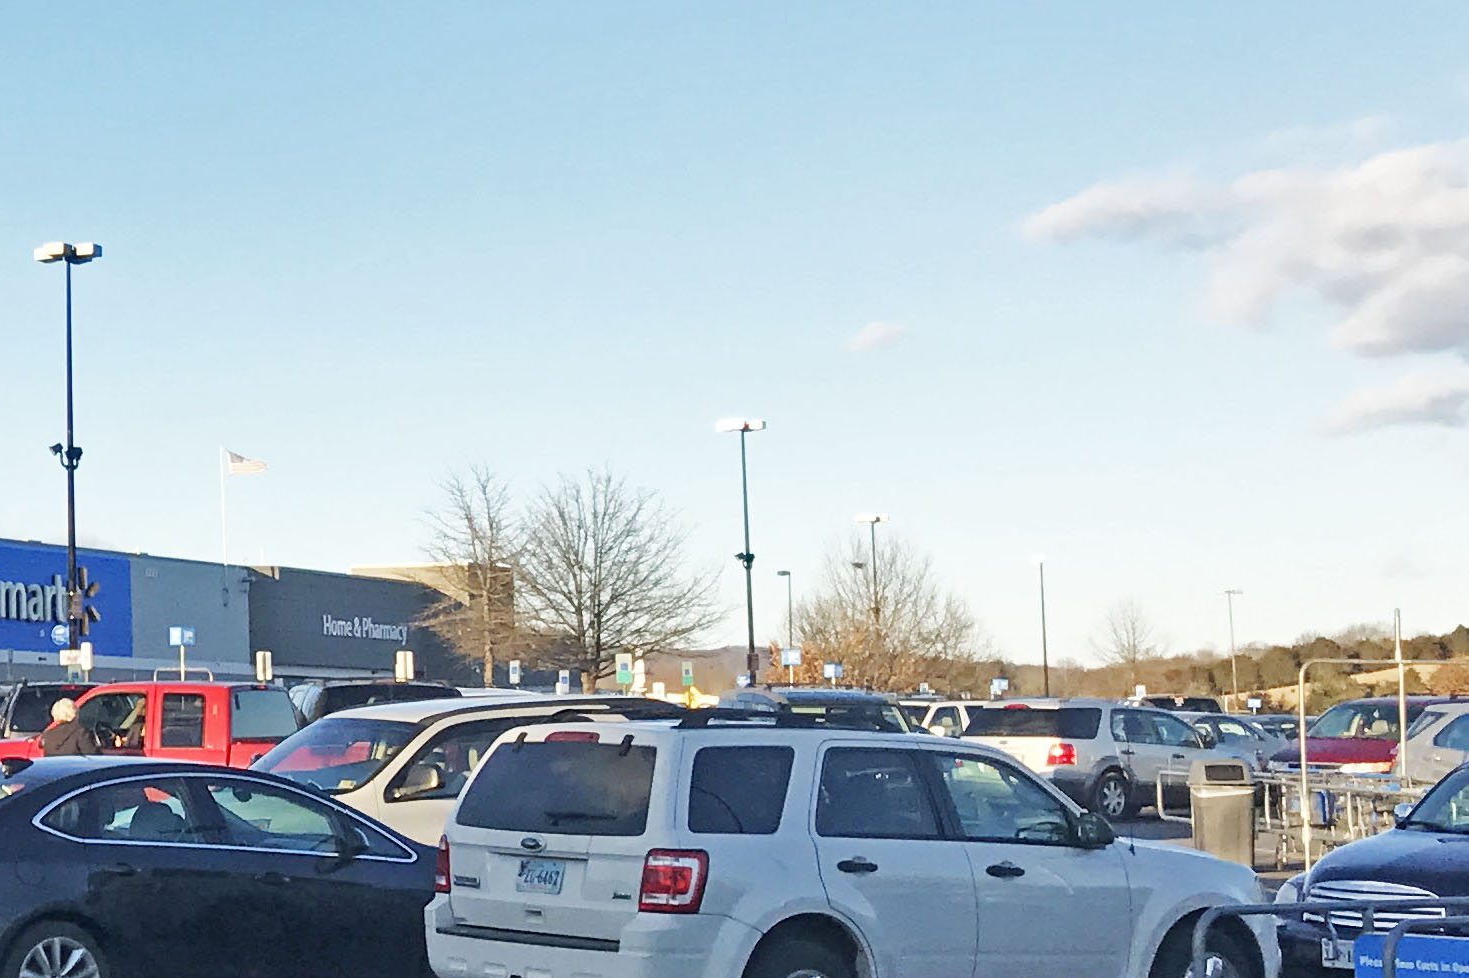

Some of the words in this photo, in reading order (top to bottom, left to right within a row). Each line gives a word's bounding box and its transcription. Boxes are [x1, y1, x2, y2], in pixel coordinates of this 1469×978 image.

[322, 614, 352, 637] Home
[353, 616, 362, 638] &
[362, 617, 408, 646] Pharmacy
